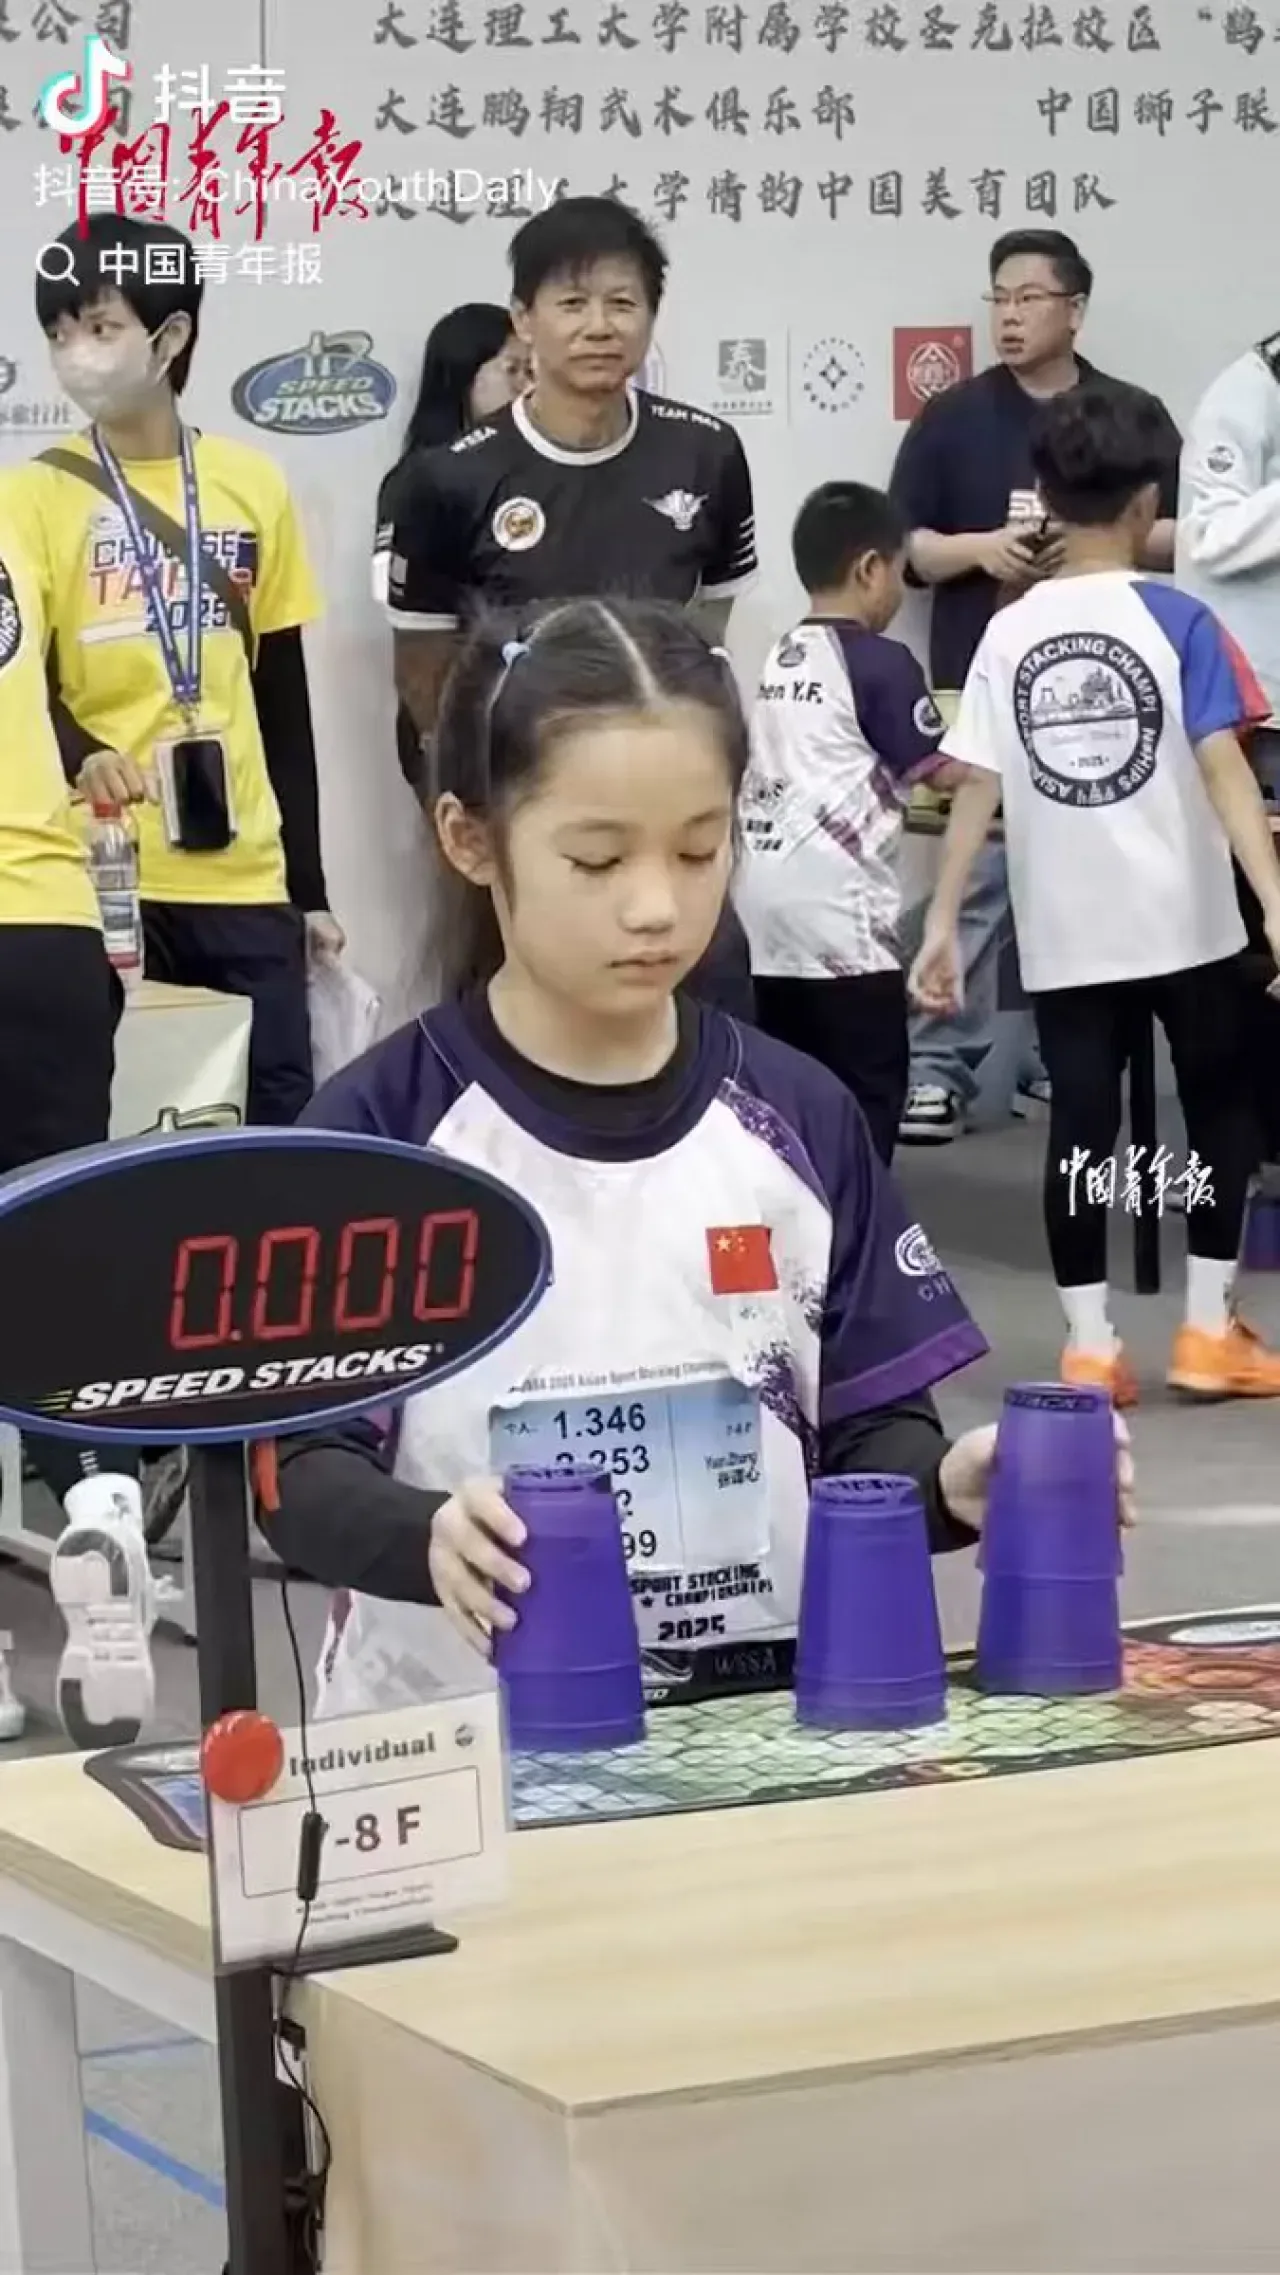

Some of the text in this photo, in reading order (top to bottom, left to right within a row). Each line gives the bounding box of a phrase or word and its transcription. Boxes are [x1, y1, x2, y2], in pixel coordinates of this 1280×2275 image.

[254, 392, 384, 422] STACKS
[277, 377, 372, 395] SPEED
[1020, 636, 1108, 684] STACKING
[169, 1208, 479, 1350] 0.000
[71, 1343, 432, 1412] SPEED STACKS
[553, 1402, 645, 1440] 1.346
[658, 1614, 725, 1641] 2025
[289, 1731, 437, 1777] Individual
[397, 1804, 420, 1846] F
